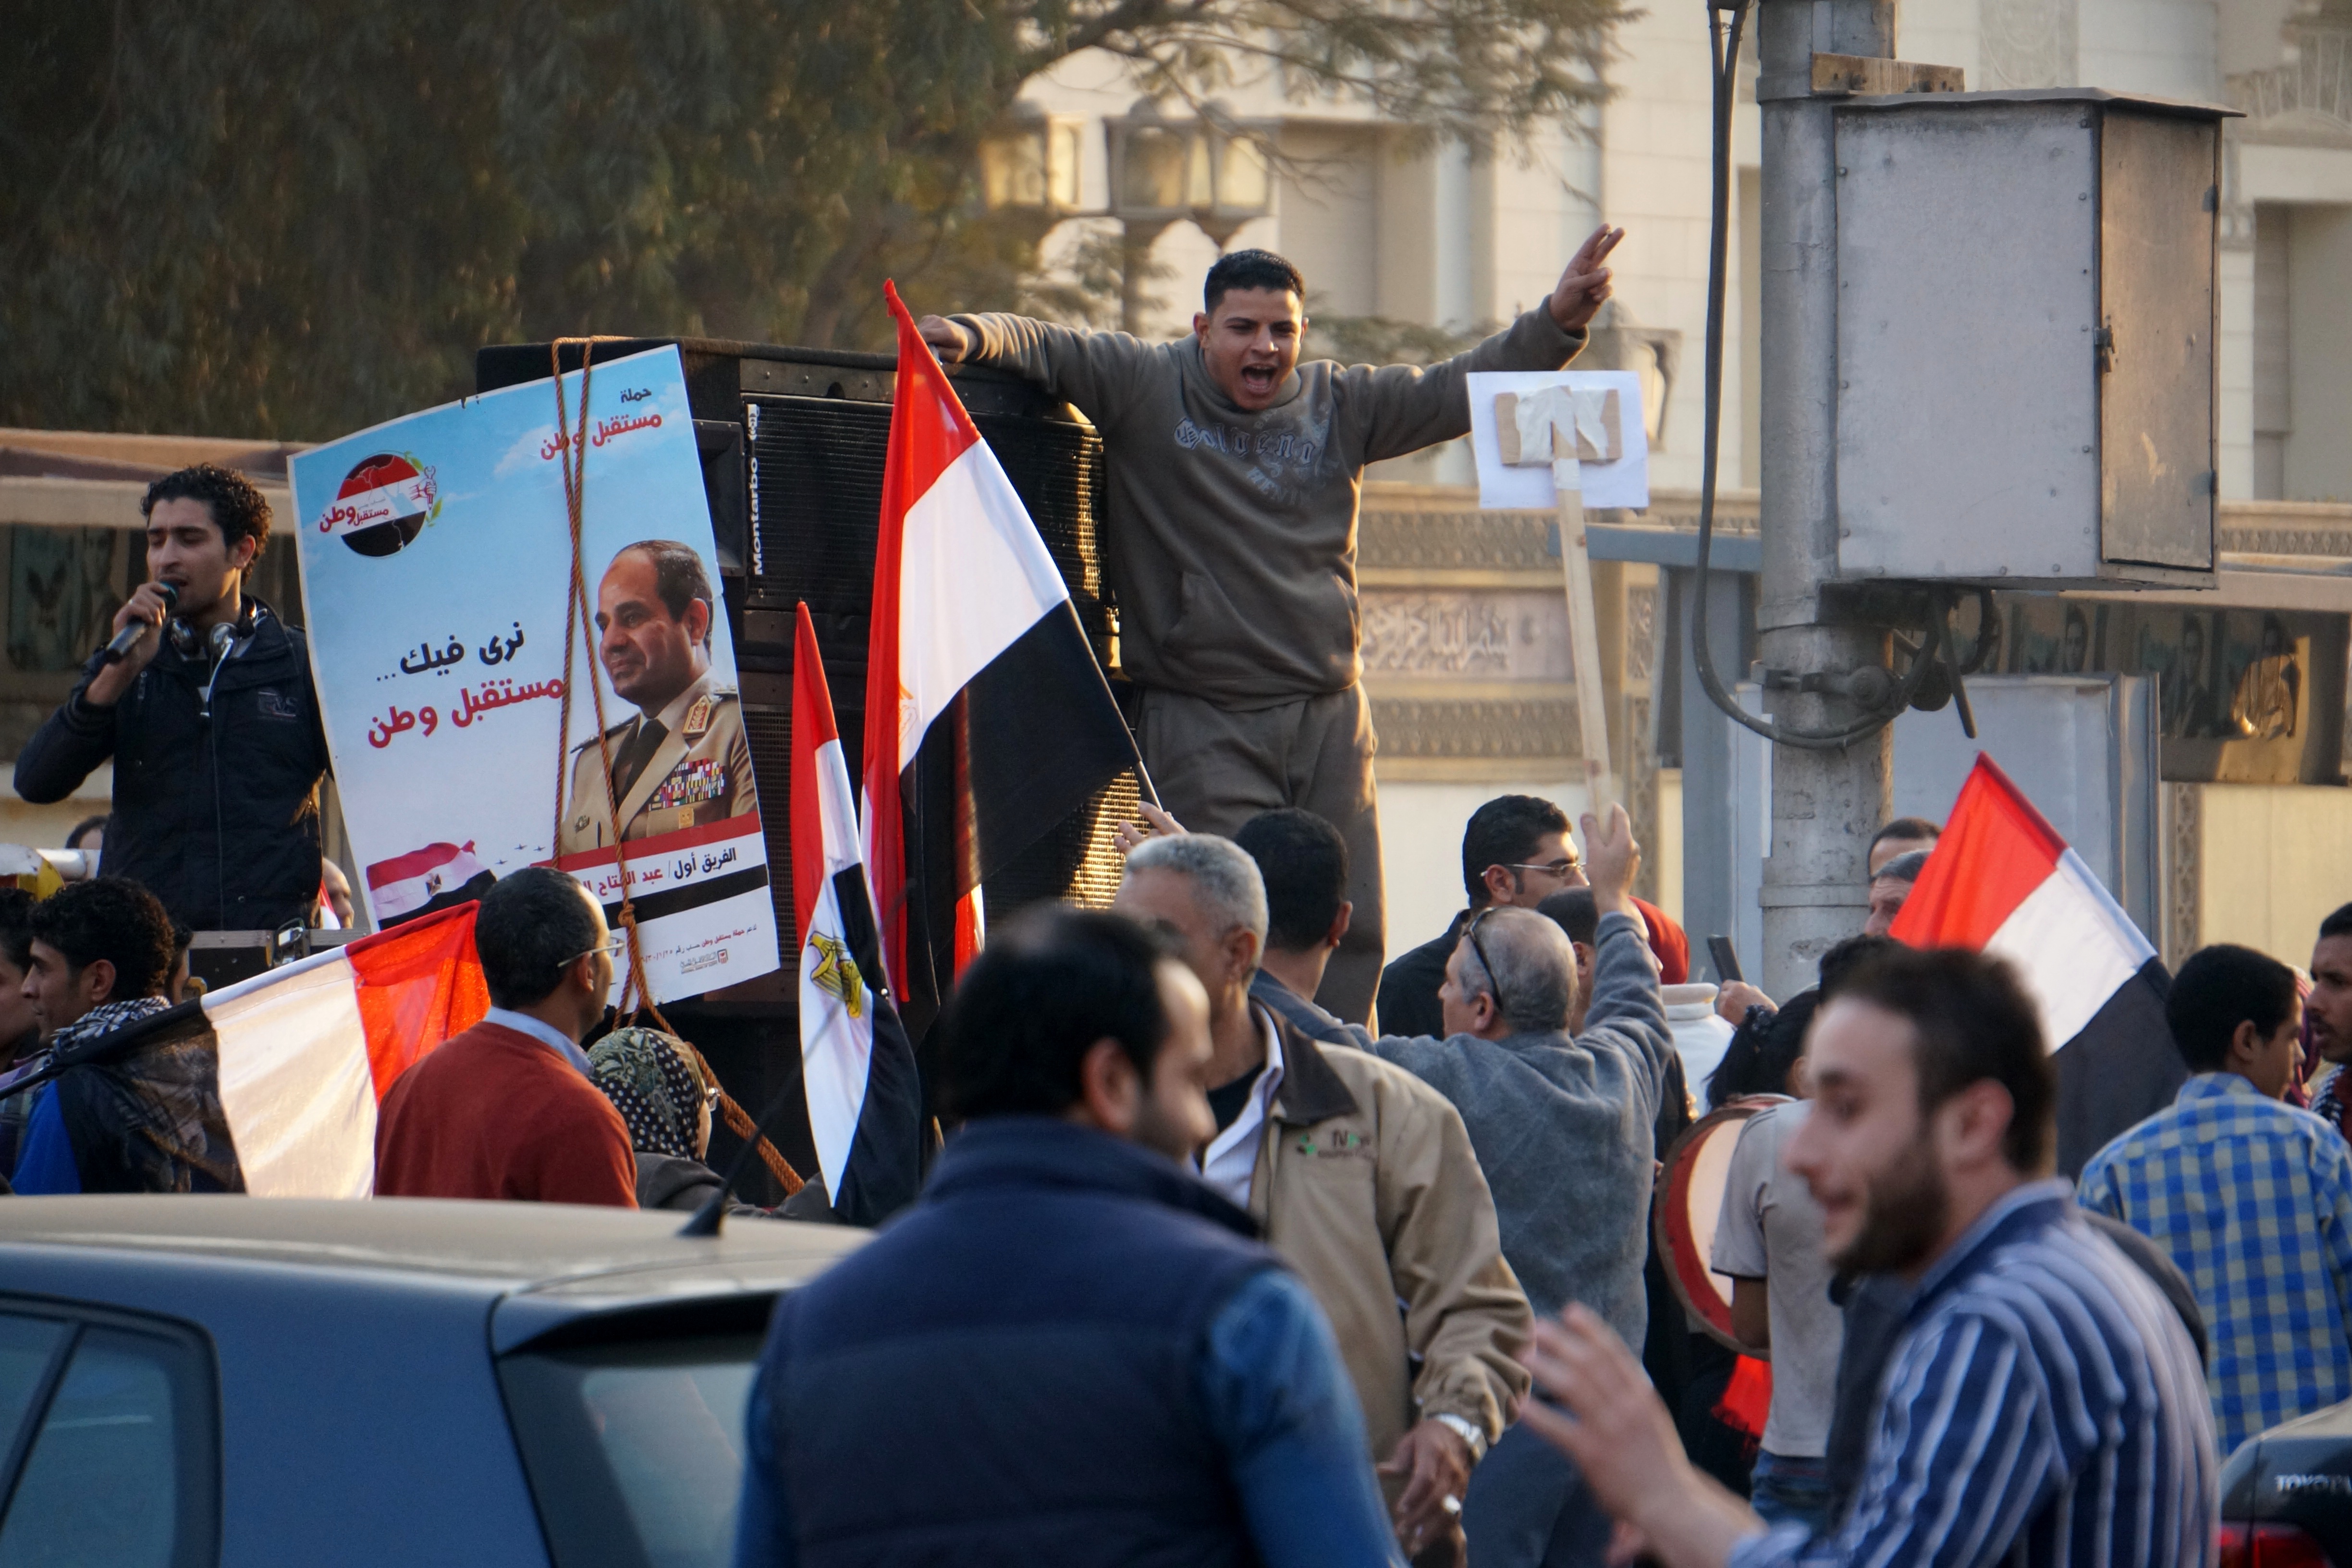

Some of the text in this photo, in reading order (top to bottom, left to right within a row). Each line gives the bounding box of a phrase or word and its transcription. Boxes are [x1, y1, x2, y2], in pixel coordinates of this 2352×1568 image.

[620, 388, 652, 403] حملة
[592, 414, 662, 447] مستقبل
[319, 506, 389, 533] مستقبل وطن
[749, 457, 763, 576] Montarbo
[479, 621, 525, 665] نرى
[368, 678, 564, 748] مستقبل وطن
[702, 846, 737, 873] الفريق
[642, 868, 663, 885] عبد
[701, 939, 713, 948] وطن
[714, 934, 732, 944] مستقبل
[732, 928, 745, 937] حملة
